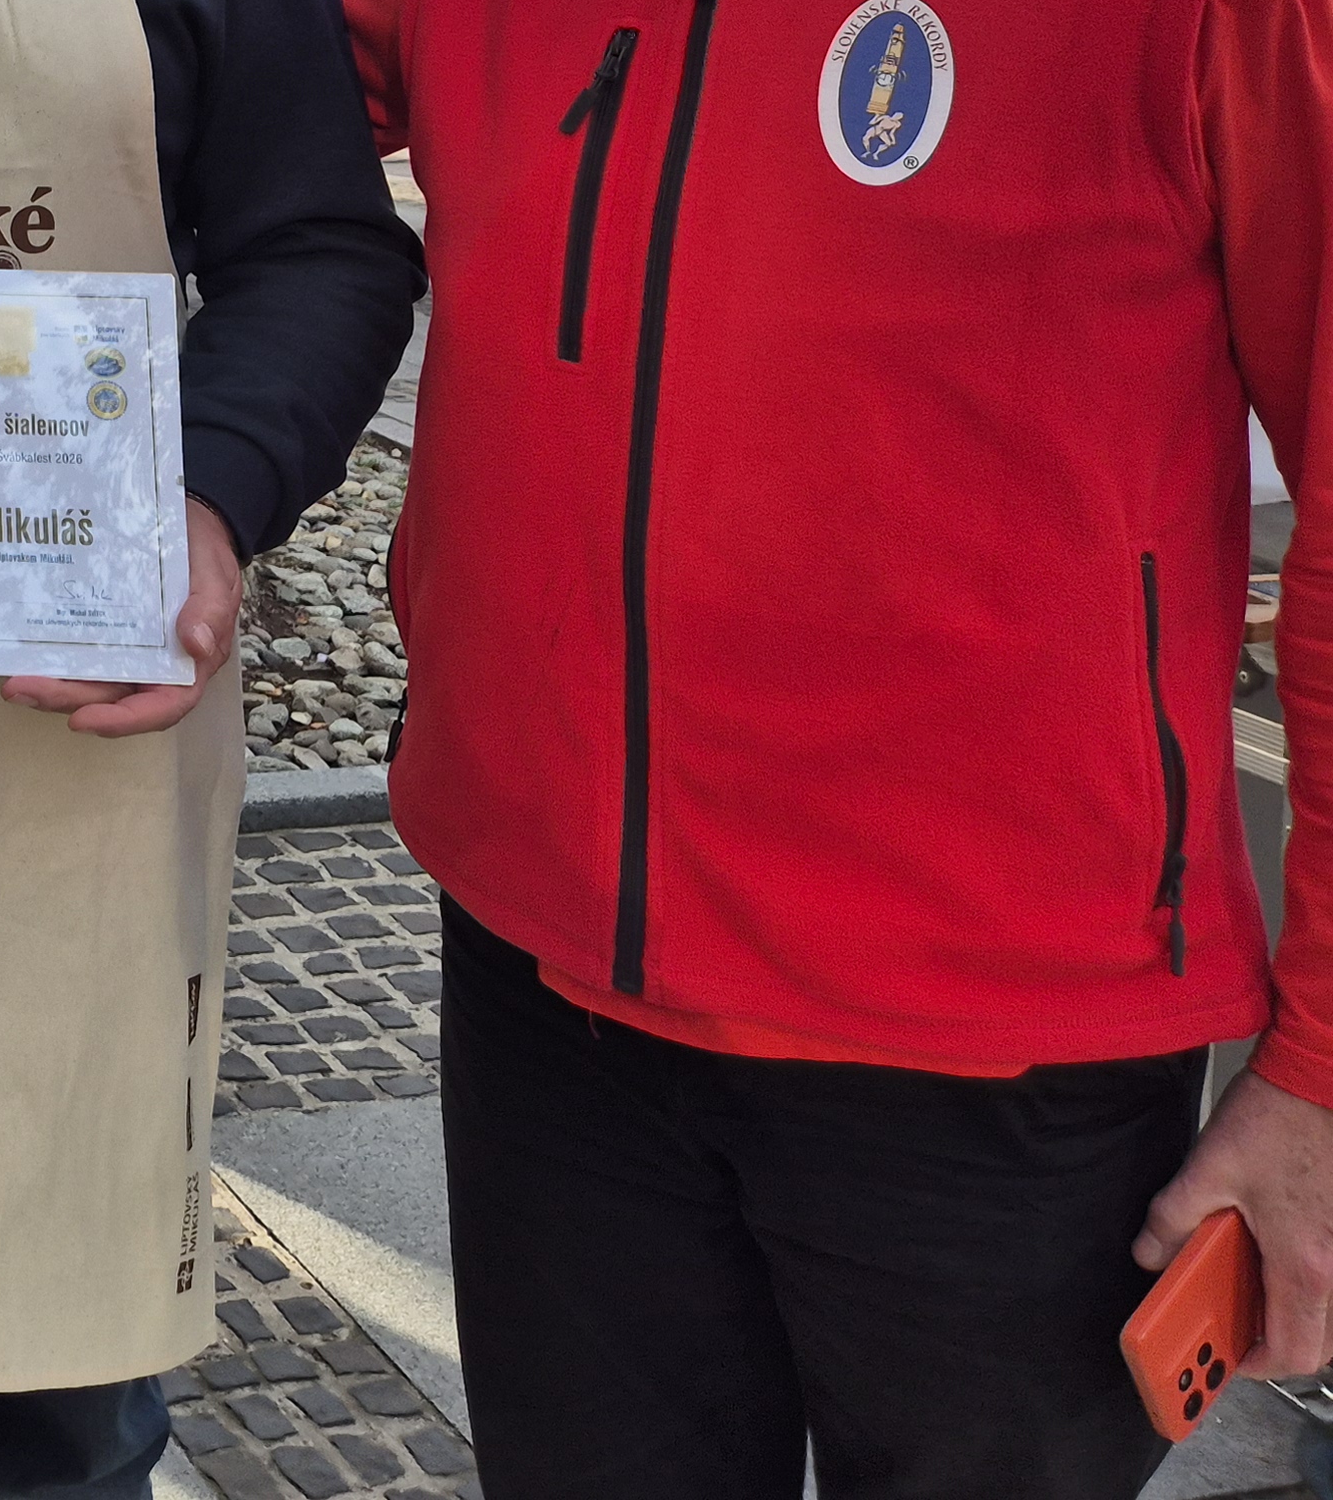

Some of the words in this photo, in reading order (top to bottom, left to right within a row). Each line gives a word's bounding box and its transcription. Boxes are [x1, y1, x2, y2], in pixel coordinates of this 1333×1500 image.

[908, 4, 948, 72] REKORDY
[4, 412, 89, 437] šialencov
[55, 452, 83, 465] 2026
